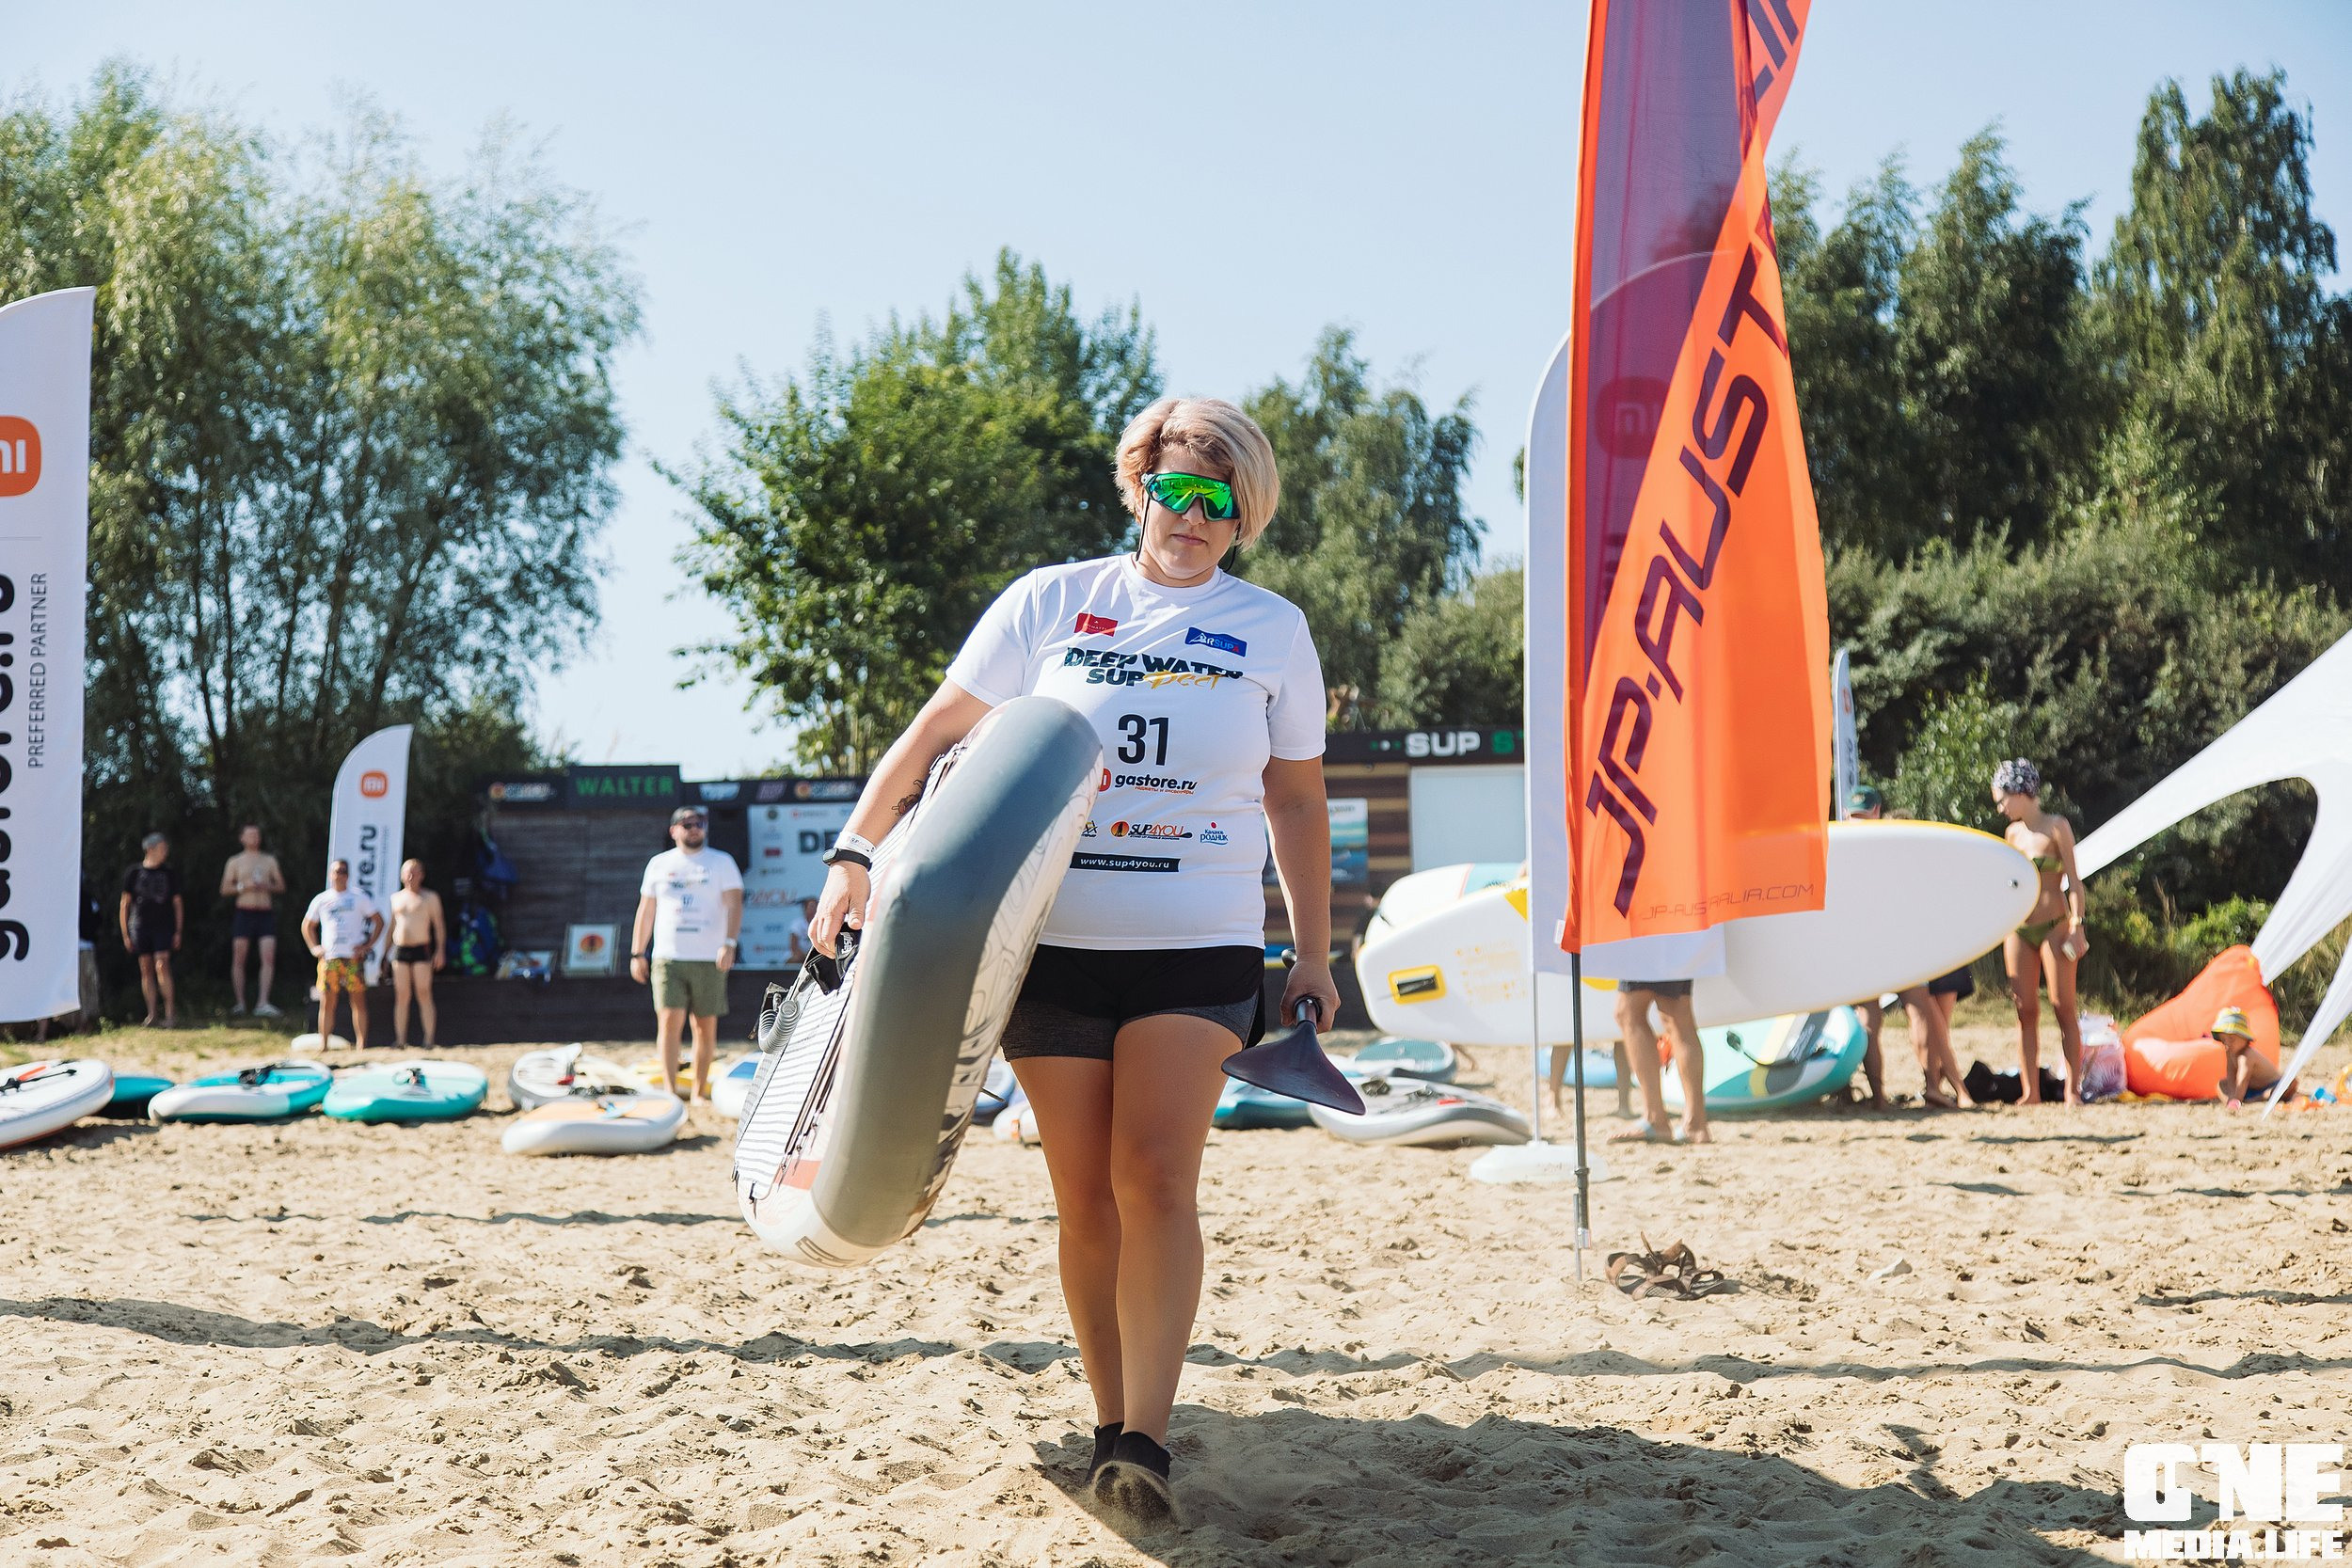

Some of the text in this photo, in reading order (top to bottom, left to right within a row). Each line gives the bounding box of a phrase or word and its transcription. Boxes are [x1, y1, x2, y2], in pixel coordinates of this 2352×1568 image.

[28, 572, 47, 768] PREFERRED PARTNER
[1064, 646, 1138, 671] DEEP
[1086, 668, 1144, 687] SUP
[1118, 713, 1169, 767] 31
[1405, 731, 1481, 757] SUP
[575, 775, 675, 798] WALTER
[1114, 773, 1198, 790] gastore.ru
[1129, 823, 1185, 837] SUP4YOU
[1080, 857, 1170, 869] www.sup4you.ru
[1642, 883, 1815, 920] JP-AUSRALIA.COM
